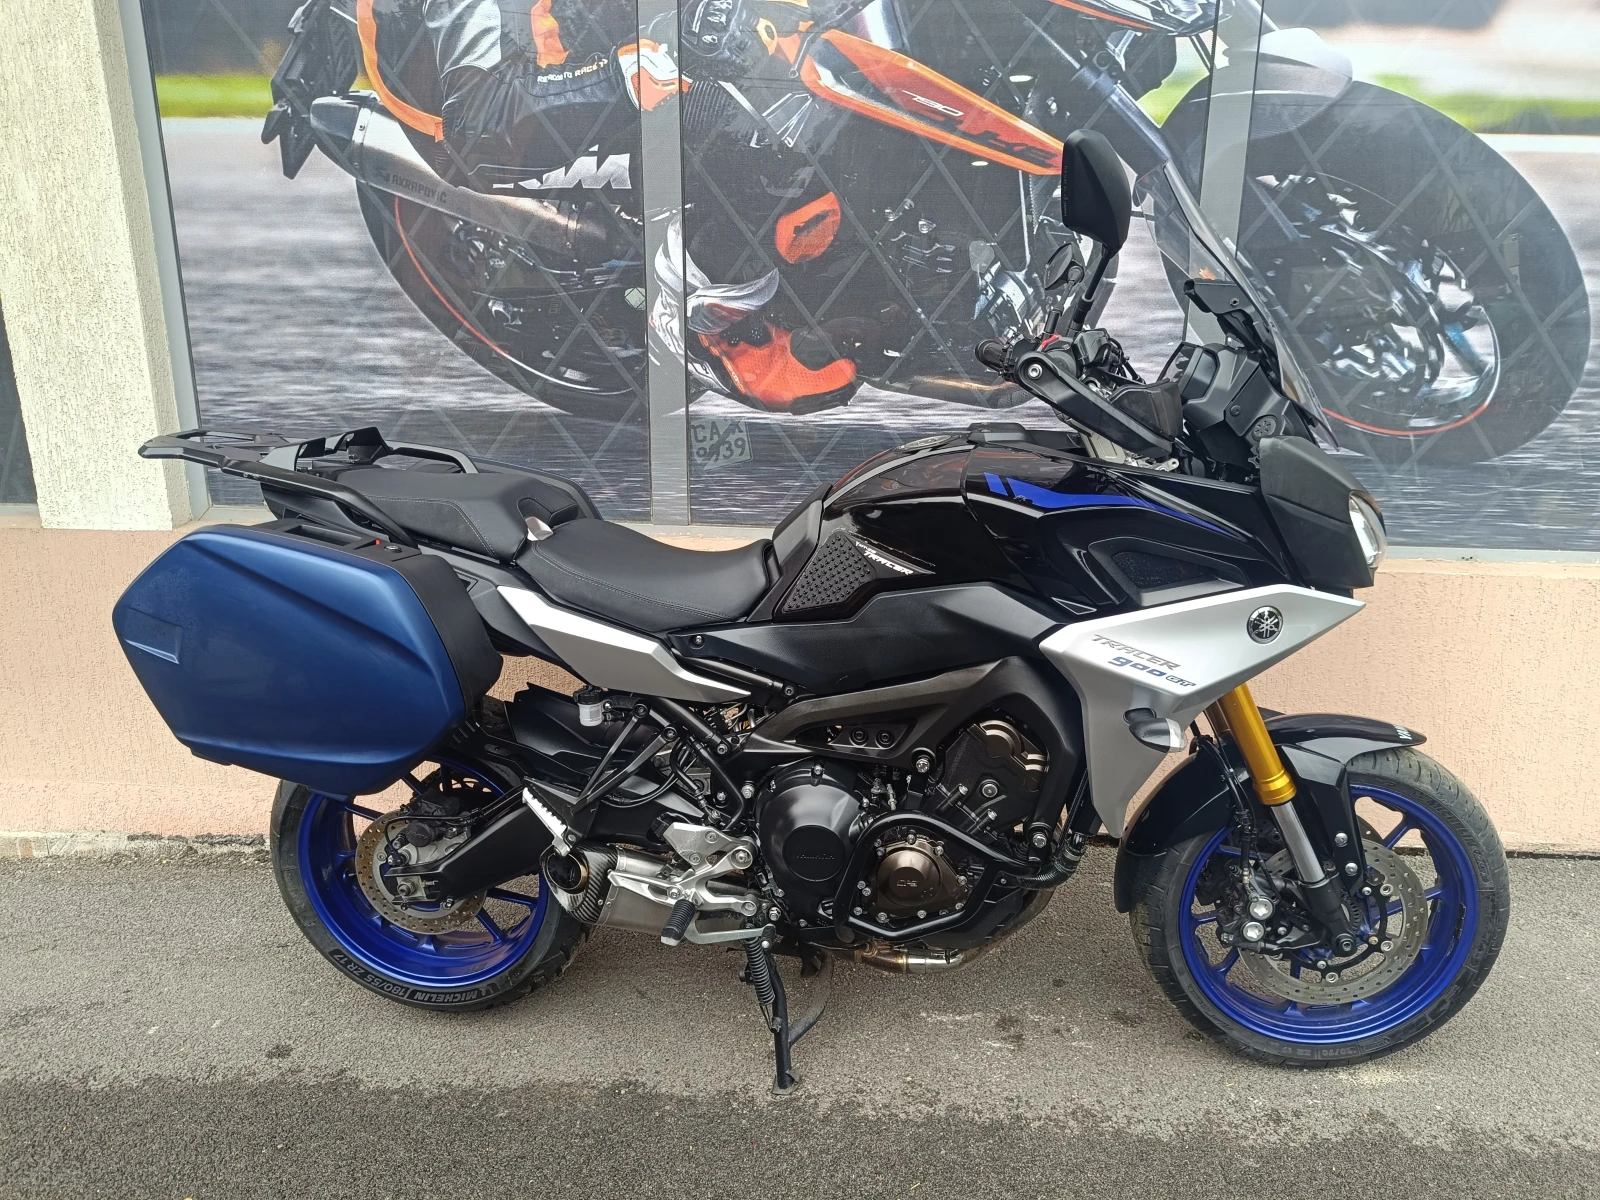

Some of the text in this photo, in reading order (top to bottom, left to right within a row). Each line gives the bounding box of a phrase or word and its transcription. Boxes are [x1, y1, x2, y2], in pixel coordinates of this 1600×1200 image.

[863, 550, 914, 575] TRACER
[1091, 633, 1182, 671] TRACER
[1107, 656, 1197, 687] 900 GT
[333, 953, 479, 1003] MICHELIN 180/55 ZR 17
